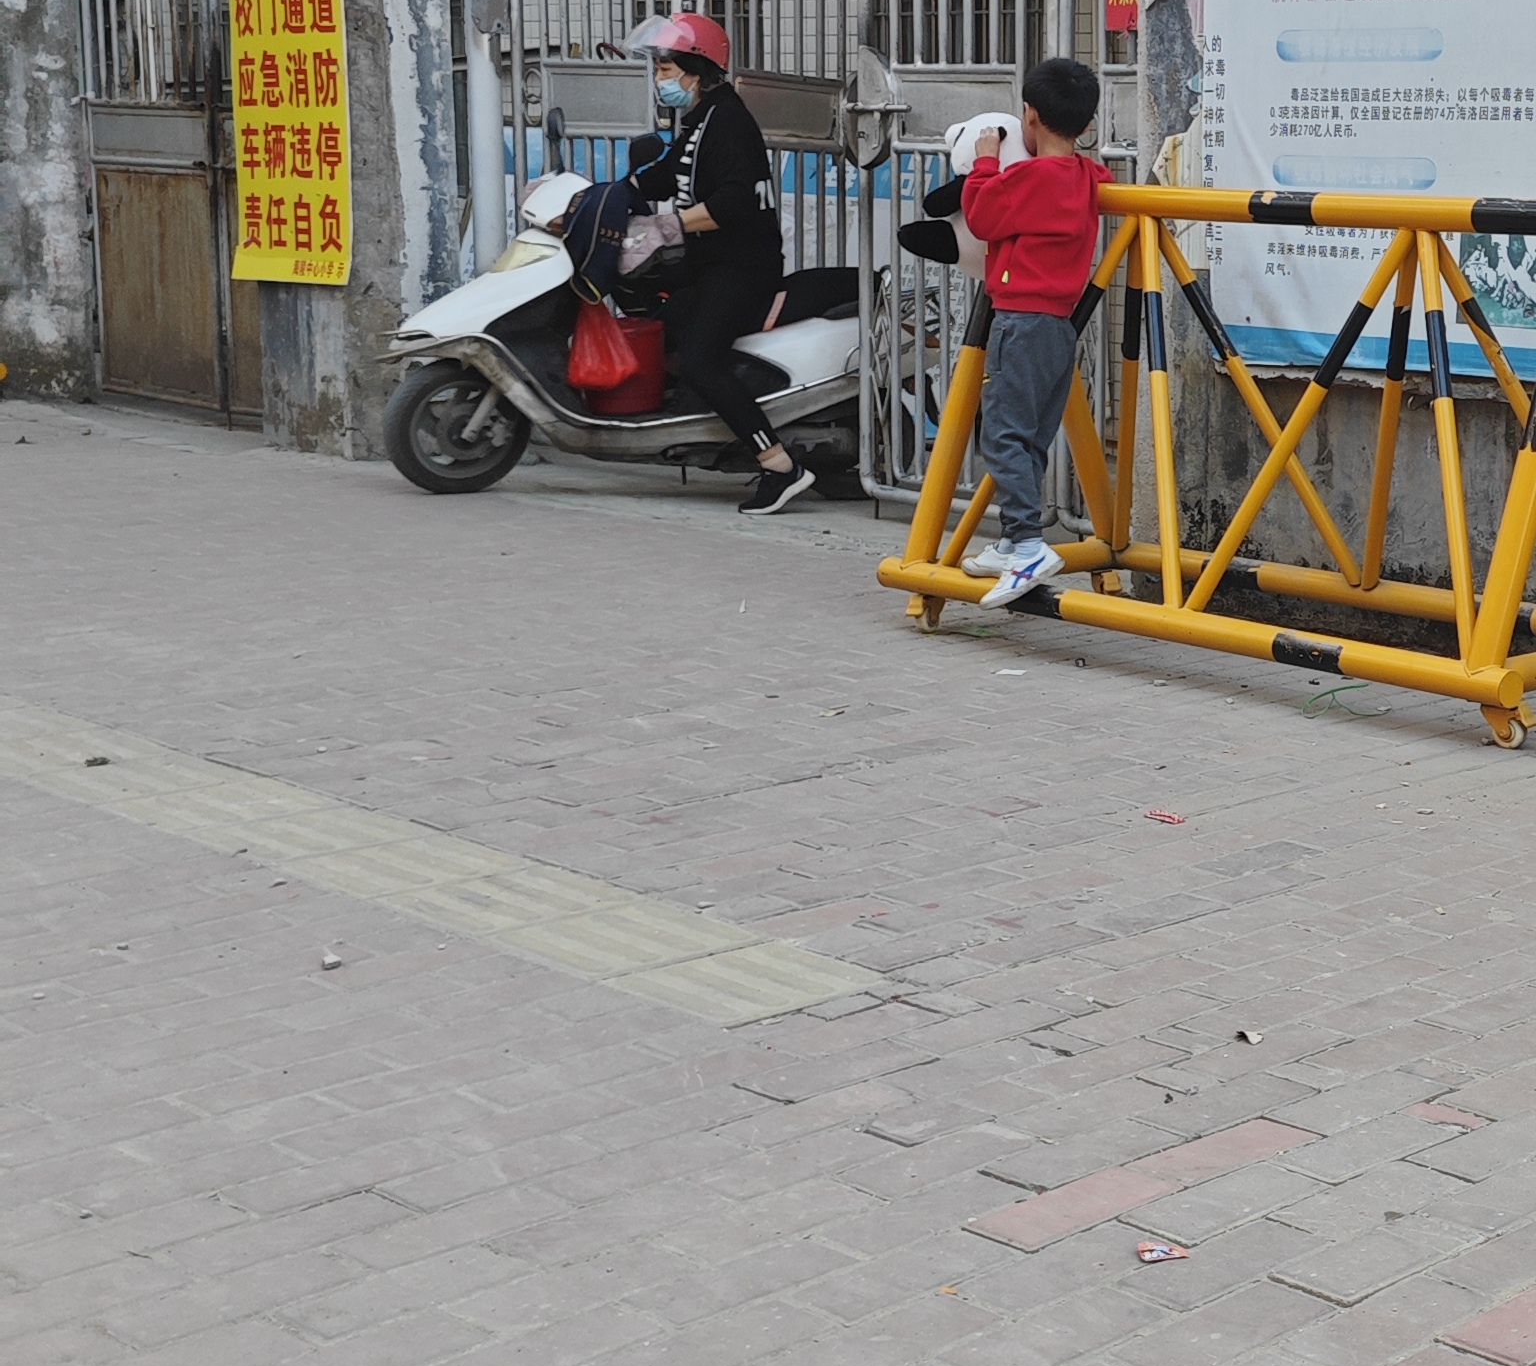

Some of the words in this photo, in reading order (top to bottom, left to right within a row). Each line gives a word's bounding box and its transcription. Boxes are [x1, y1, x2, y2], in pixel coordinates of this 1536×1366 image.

[237, 47, 340, 109] 应急消防
[240, 120, 343, 182] 车辆违停
[243, 191, 343, 253] 责任自负
[1264, 262, 1291, 276] 风气。
